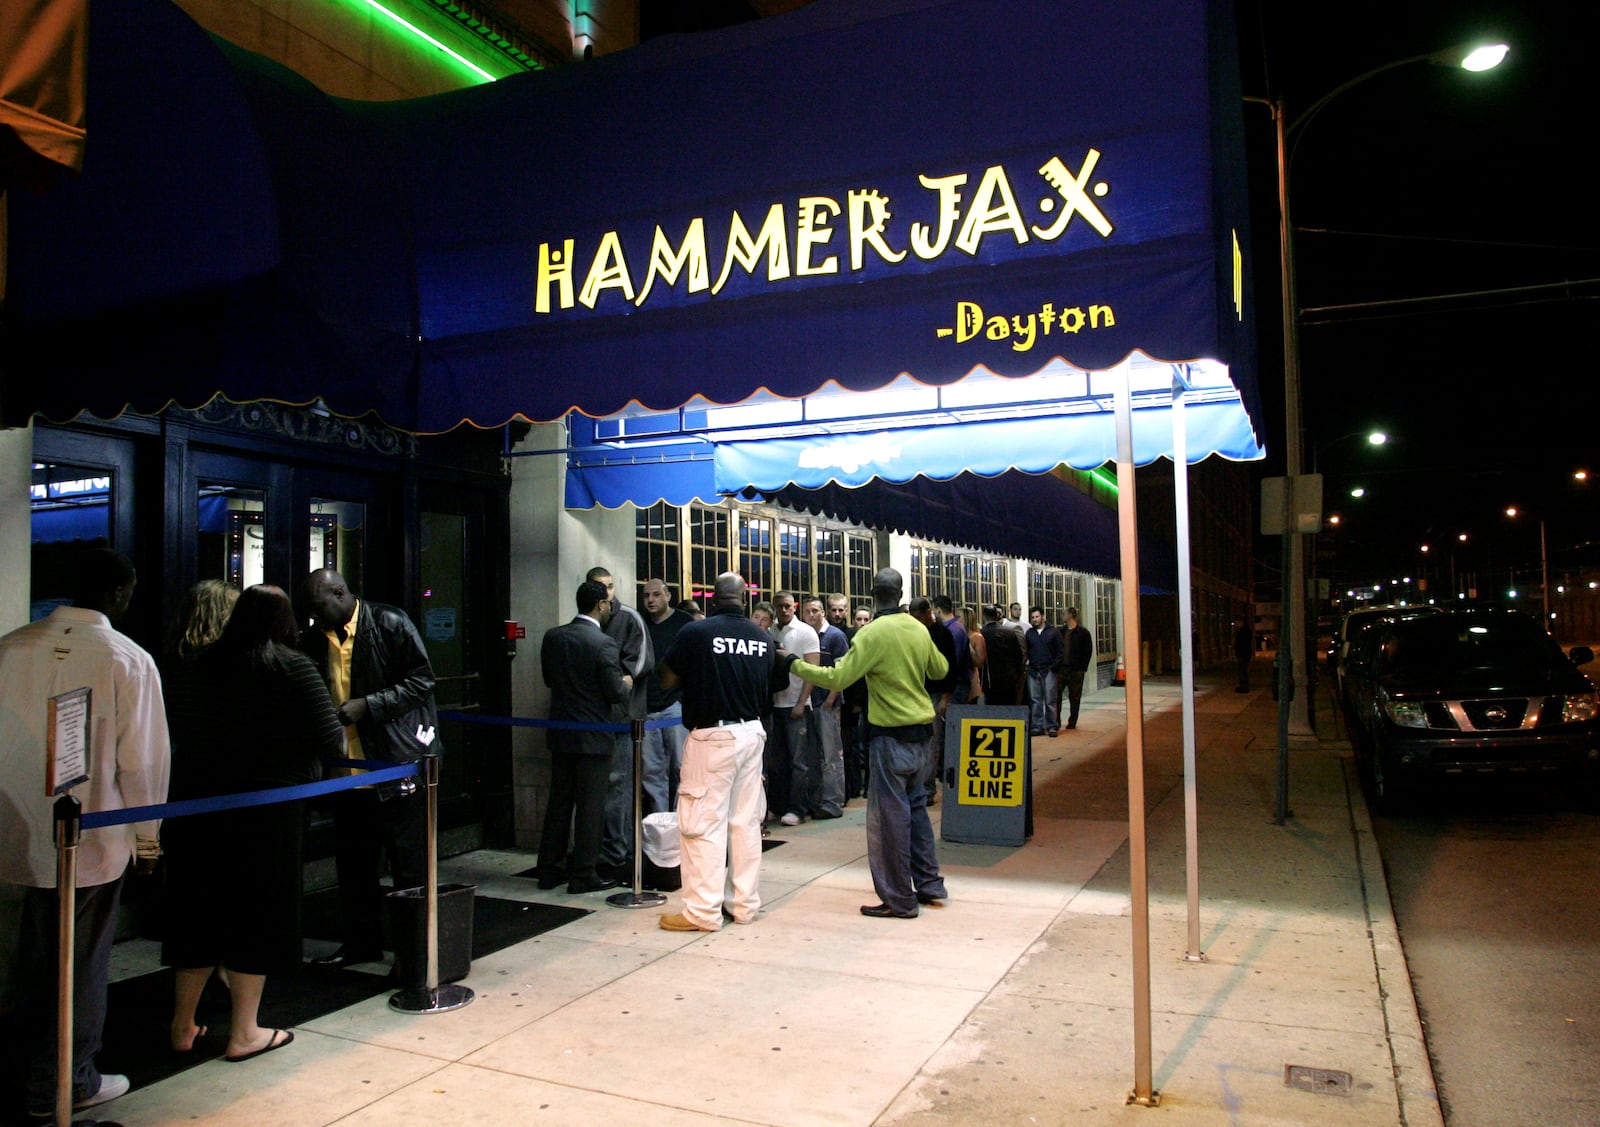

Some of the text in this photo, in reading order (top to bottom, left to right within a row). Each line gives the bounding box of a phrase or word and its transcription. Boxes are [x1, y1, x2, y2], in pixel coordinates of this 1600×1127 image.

[712, 636, 768, 657] STAFF
[975, 728, 1010, 757] 21
[966, 760, 1017, 779] & UP
[968, 780, 1013, 799] LINE
